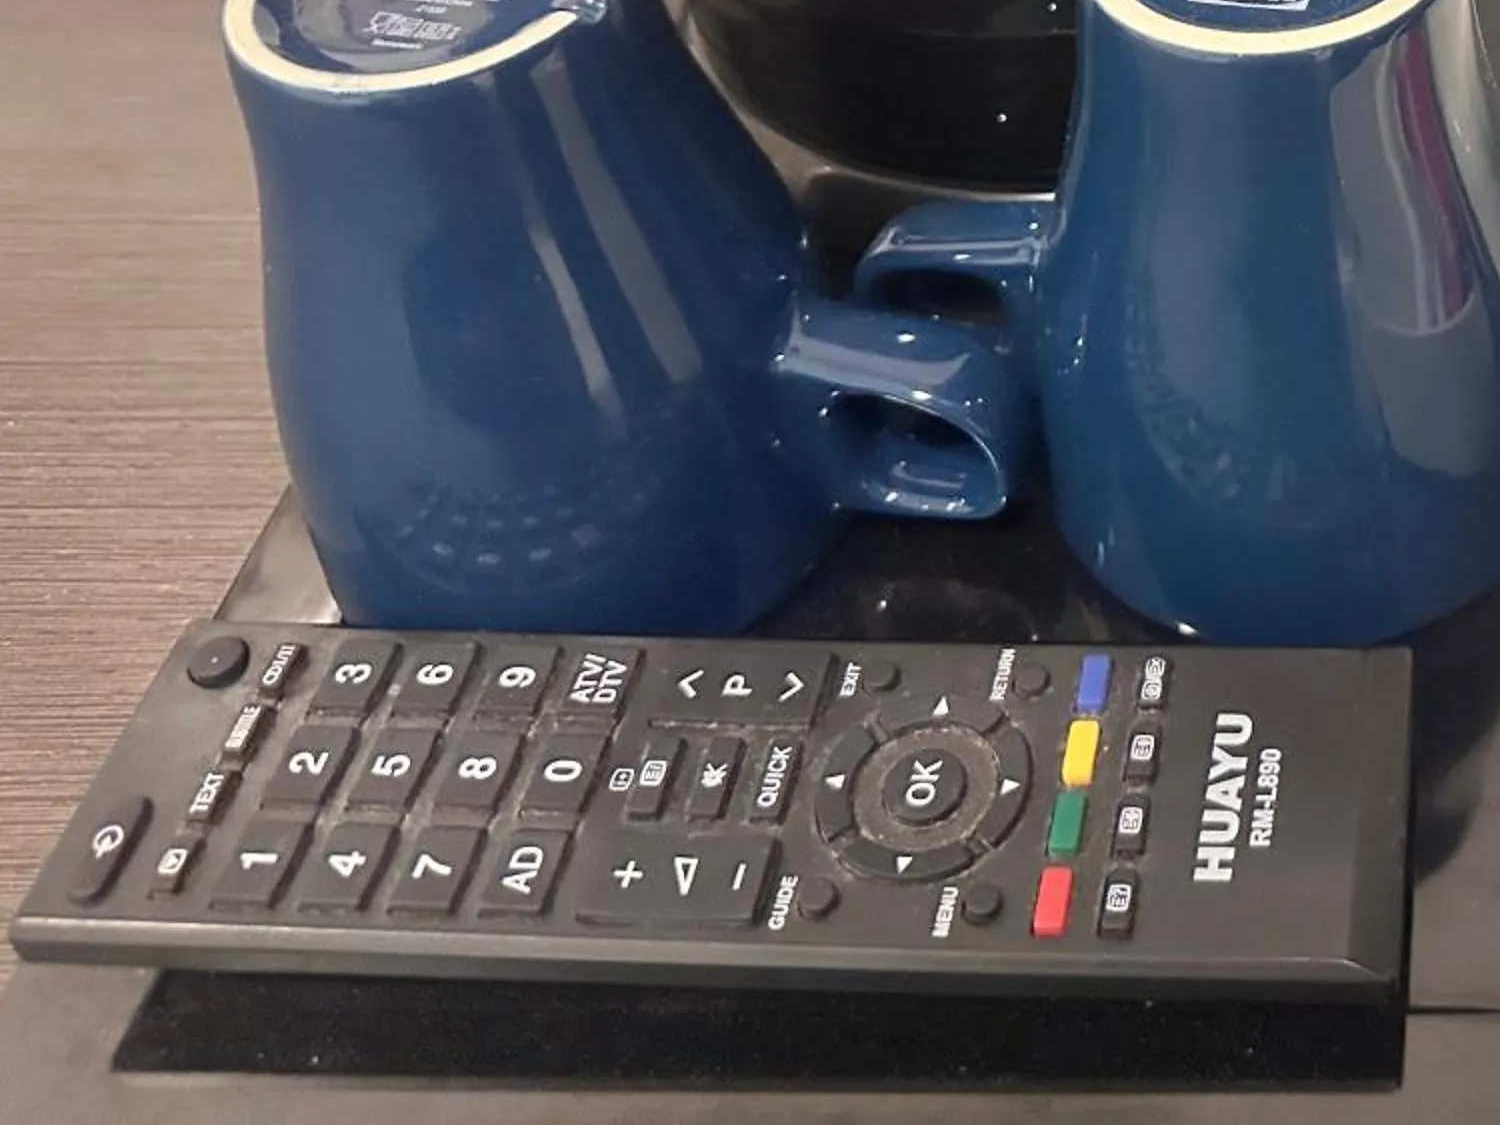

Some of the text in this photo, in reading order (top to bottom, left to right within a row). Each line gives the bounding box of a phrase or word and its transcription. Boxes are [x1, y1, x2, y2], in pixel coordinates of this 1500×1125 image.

[335, 664, 372, 684] 3
[416, 664, 454, 685] 6
[499, 666, 536, 688] 9
[593, 658, 627, 705] DTV
[722, 674, 753, 696] P
[839, 662, 861, 697] EXIT
[989, 648, 1016, 701] RETURN
[288, 752, 329, 775] 2
[371, 754, 411, 777] 5
[458, 757, 497, 780] 8
[544, 760, 582, 782] 0
[757, 746, 793, 808] QUICK
[189, 772, 225, 814] TEXT
[905, 760, 943, 807] OK
[1193, 713, 1254, 883] HUAYU
[1248, 747, 1282, 848] RM-L890
[240, 851, 278, 869] 1
[328, 850, 366, 877] 4
[412, 854, 452, 879] 7
[502, 845, 543, 894] AD
[767, 875, 799, 930] GUIDE
[932, 886, 959, 938] MENU
